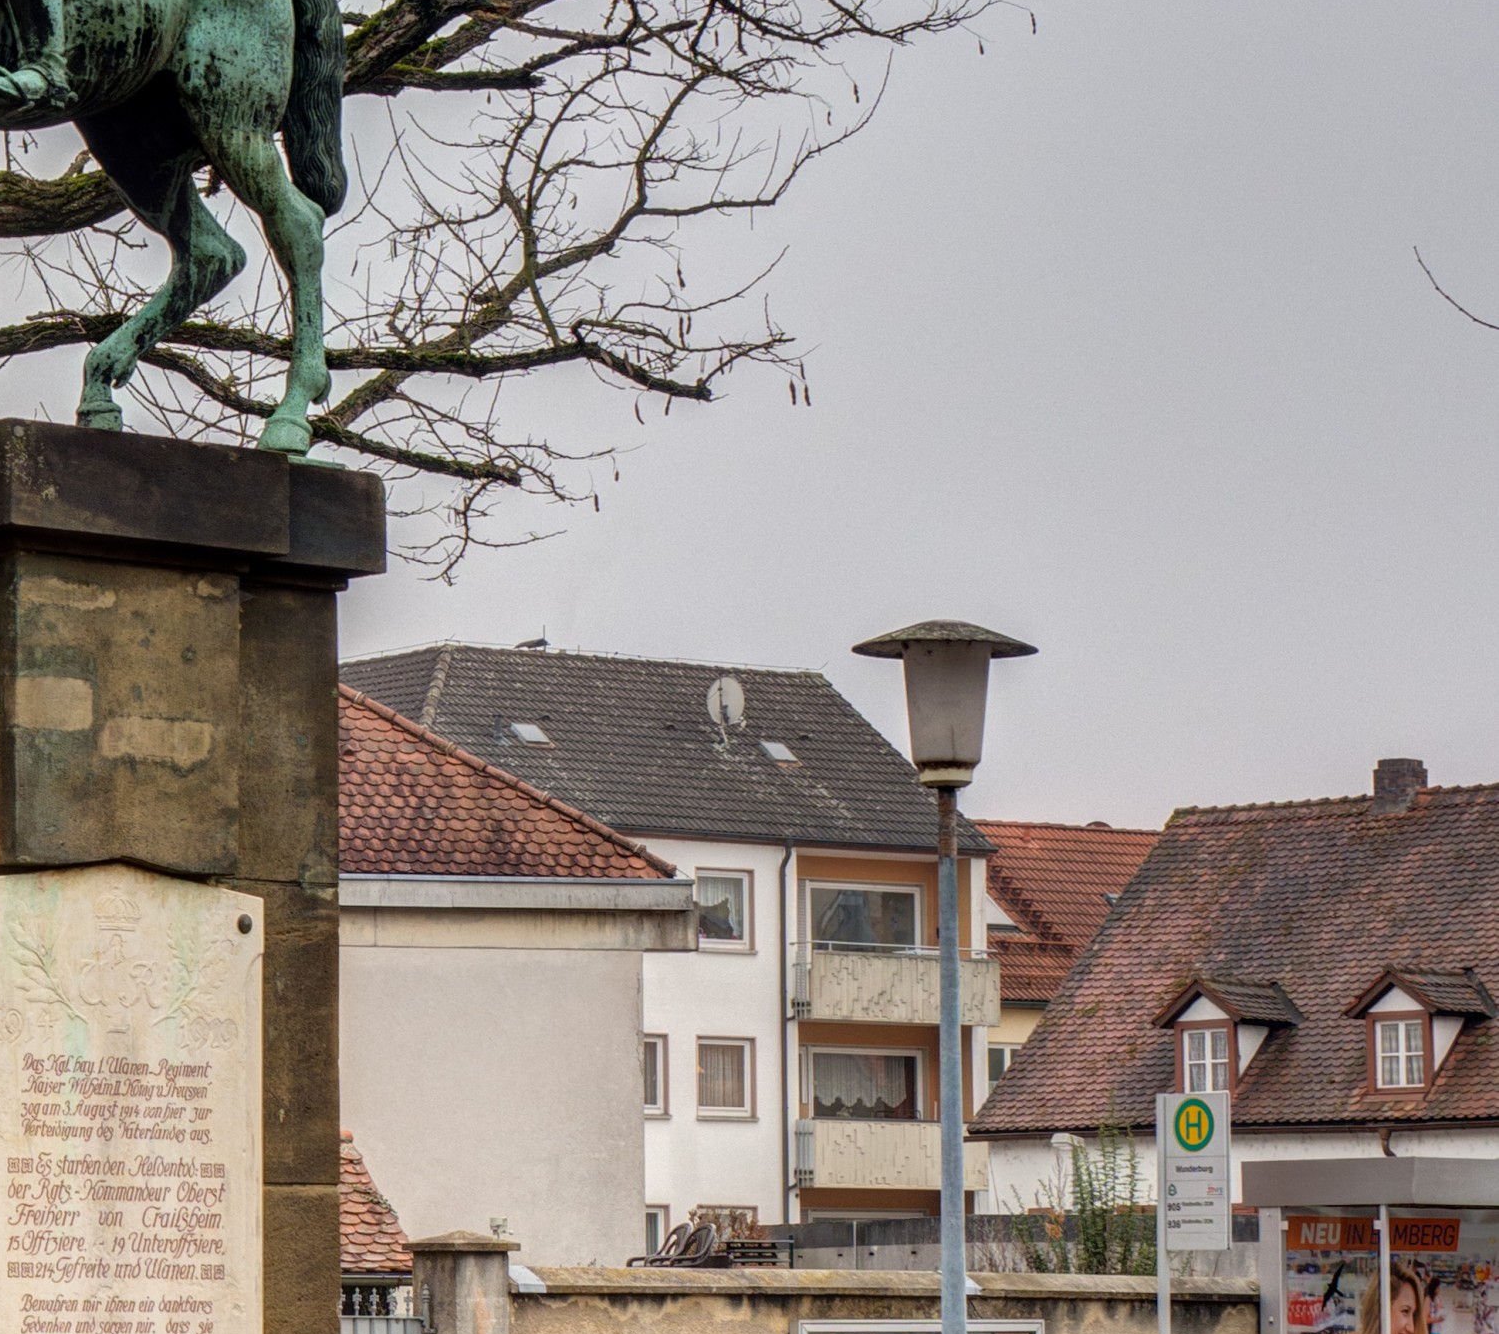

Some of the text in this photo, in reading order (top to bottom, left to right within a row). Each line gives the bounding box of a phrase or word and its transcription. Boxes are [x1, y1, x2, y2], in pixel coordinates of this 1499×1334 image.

[21, 1053, 44, 1074] Das
[68, 1076, 114, 1099] Wilhelm
[122, 1078, 154, 1101] König
[21, 1100, 213, 1123] zog am 3. August 1914 von hier zur
[21, 1117, 213, 1144] Verteidigung des Vaterlandes aus.
[1186, 1111, 1202, 1140] H
[36, 1152, 52, 1177] Es
[53, 1154, 102, 1177] starben
[103, 1156, 125, 1177] den
[7, 1177, 31, 1199] der
[176, 1181, 226, 1207] Oberst
[8, 1203, 80, 1228] Freiherr
[98, 1210, 123, 1227] von
[7, 1235, 21, 1252] 15
[111, 1235, 125, 1255] 19
[1300, 1222, 1456, 1247] NEU IN BMBERG
[35, 1261, 53, 1278] 214
[53, 1256, 111, 1283] Gefreite
[114, 1257, 141, 1279] und
[20, 1293, 213, 1317] Bewahren wir ihnen ein dankbares
[21, 1315, 71, 1334] Gedenken
[75, 1317, 96, 1333] und
